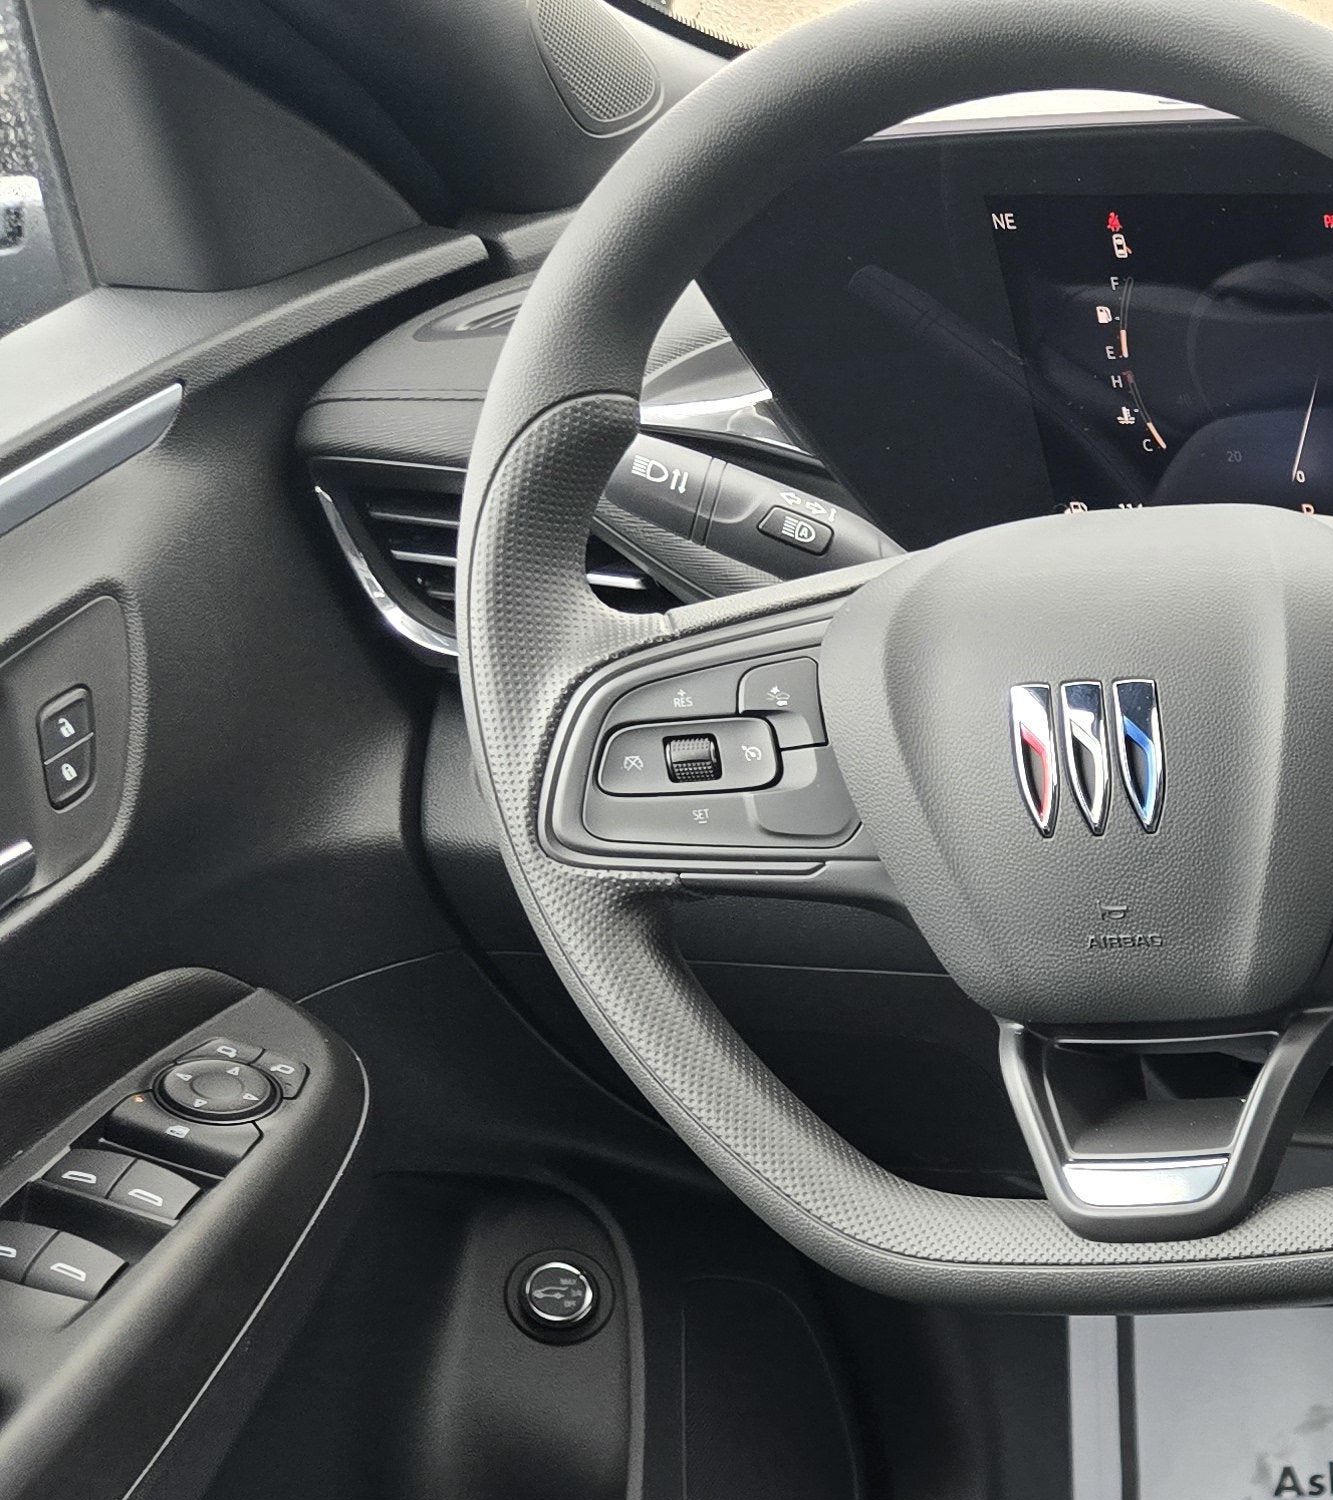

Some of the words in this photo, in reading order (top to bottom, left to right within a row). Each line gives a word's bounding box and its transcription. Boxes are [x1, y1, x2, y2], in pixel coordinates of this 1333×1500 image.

[992, 213, 1017, 230] NE
[1110, 277, 1119, 290] F
[1106, 346, 1116, 359] E
[1111, 376, 1123, 388] H
[1143, 439, 1153, 452] C
[673, 697, 693, 708] RES
[692, 808, 710, 821] SET
[1087, 933, 1164, 950] AIRBAG
